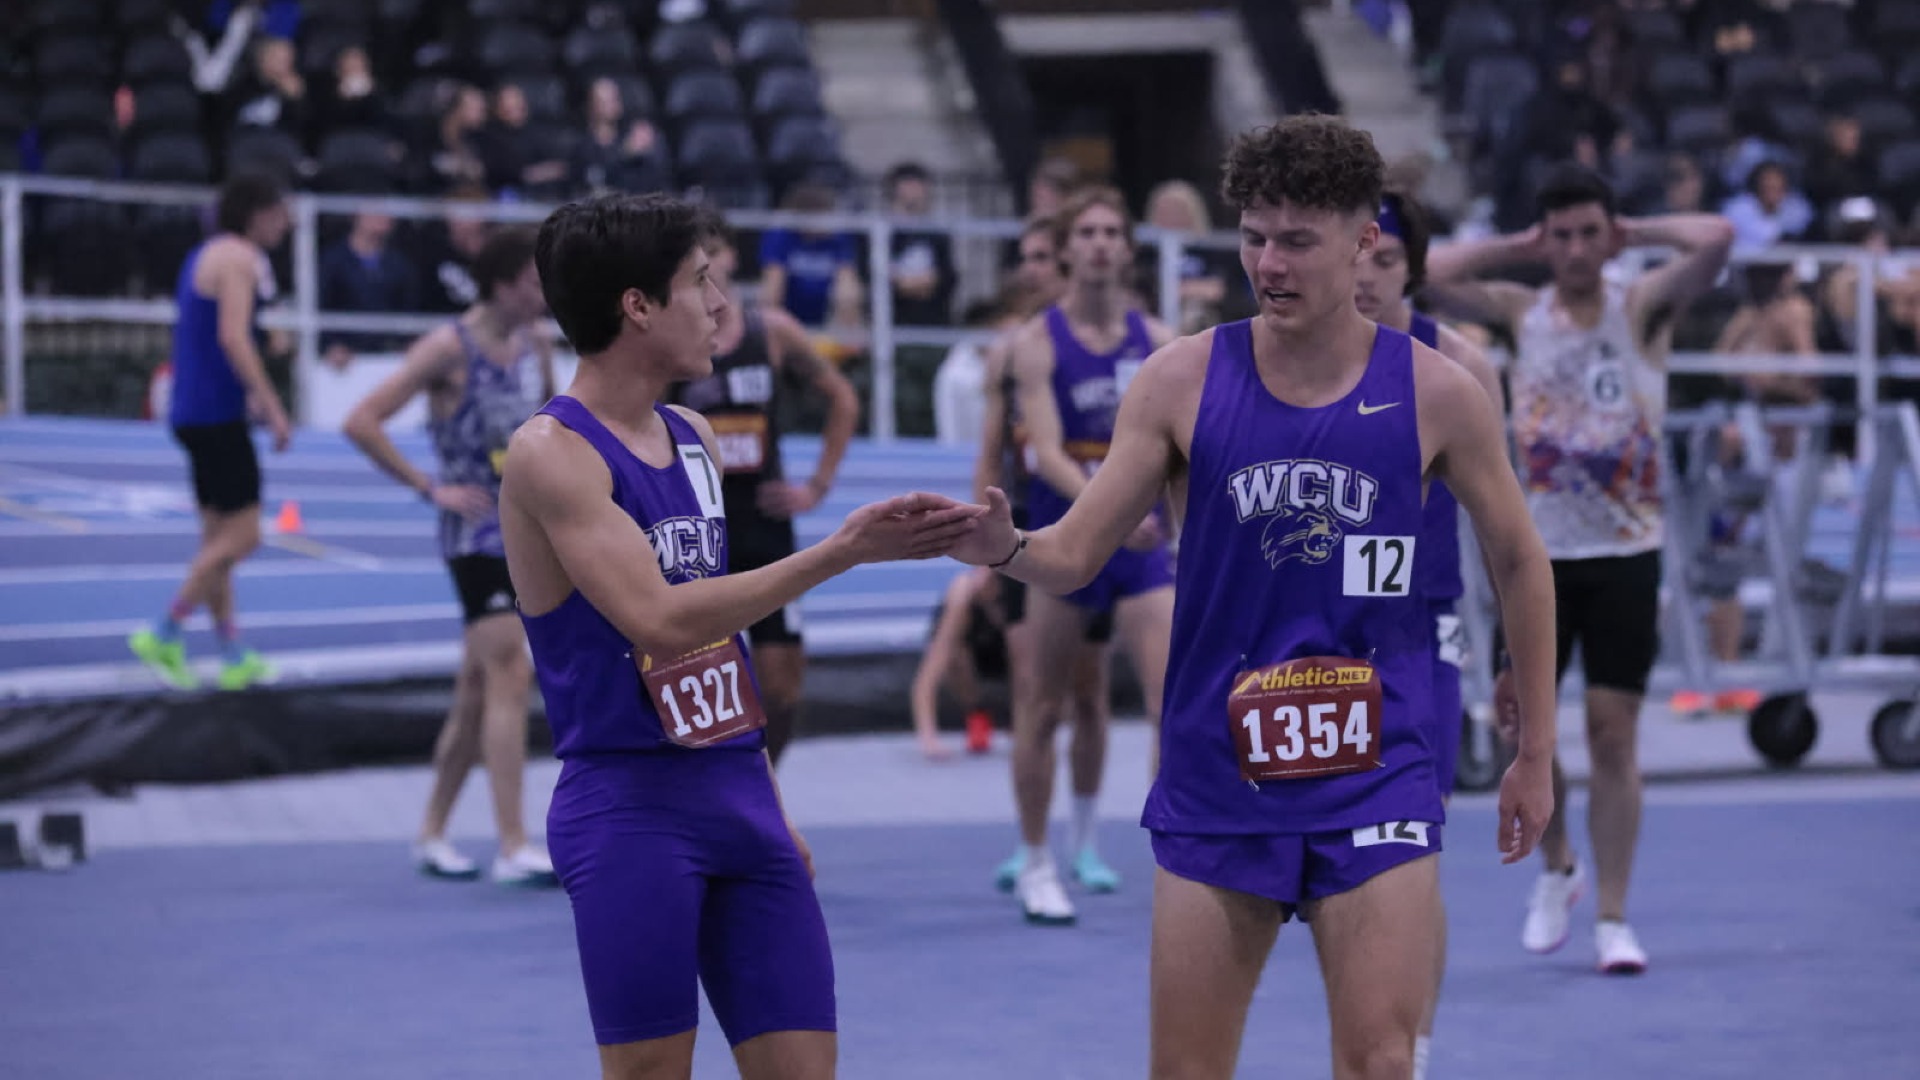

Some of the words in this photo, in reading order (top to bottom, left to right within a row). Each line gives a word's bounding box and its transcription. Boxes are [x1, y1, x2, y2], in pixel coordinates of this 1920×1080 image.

[684, 451, 717, 505] 7
[1228, 458, 1379, 528] WCU
[1358, 538, 1405, 593] 12
[661, 660, 744, 737] 1327
[1242, 700, 1373, 763] 1354
